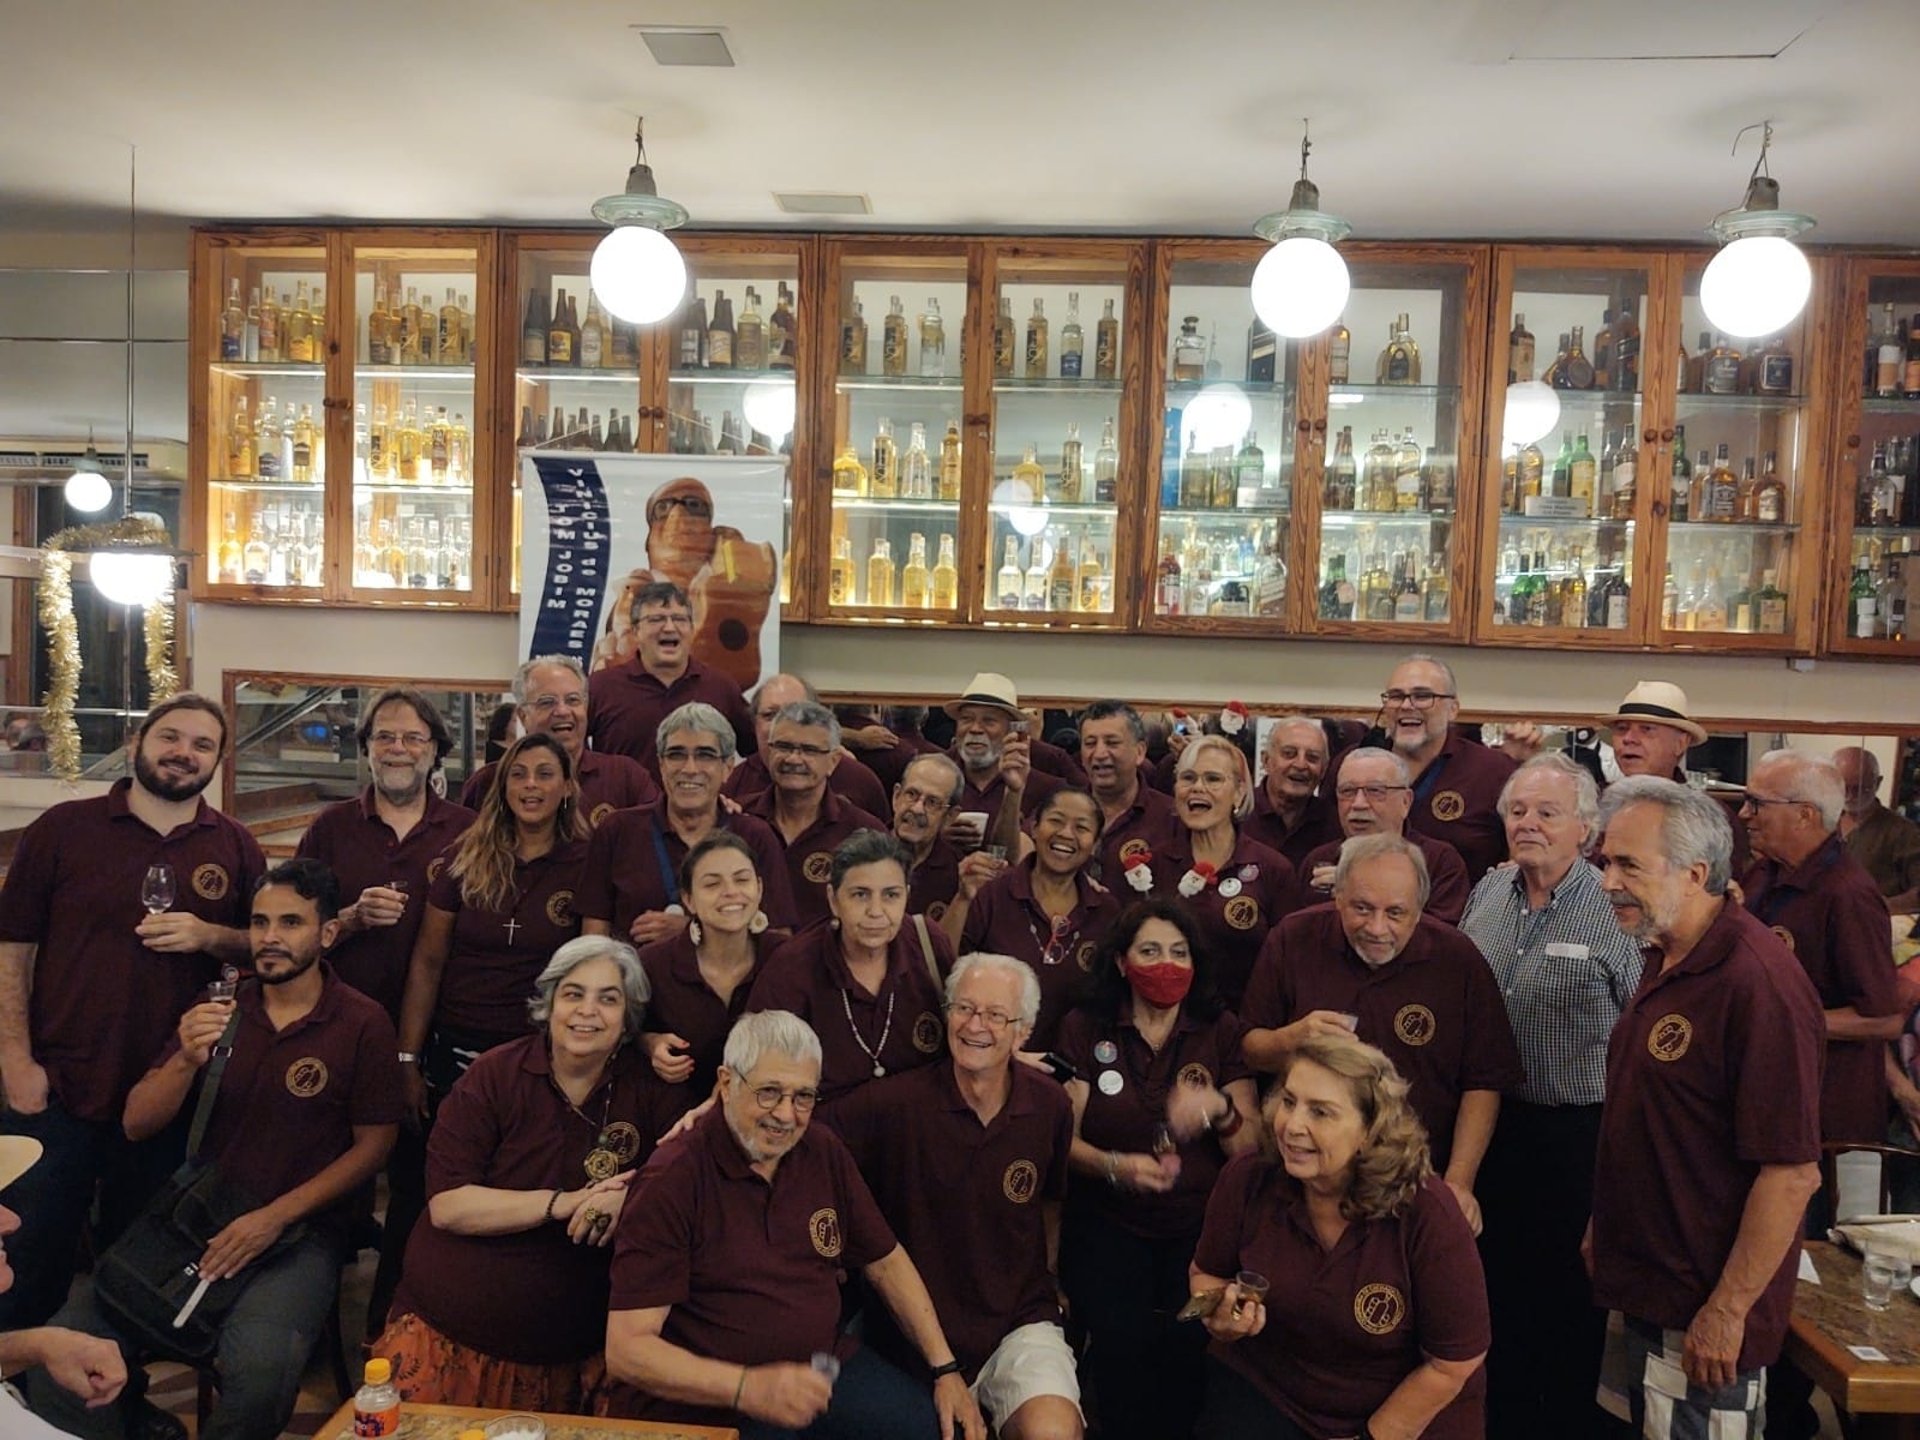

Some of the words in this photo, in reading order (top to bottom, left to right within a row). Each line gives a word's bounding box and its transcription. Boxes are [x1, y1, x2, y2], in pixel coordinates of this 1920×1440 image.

[567, 468, 600, 550] VINICIUS
[546, 550, 573, 609] JOBIM
[567, 587, 597, 649] MORAES
